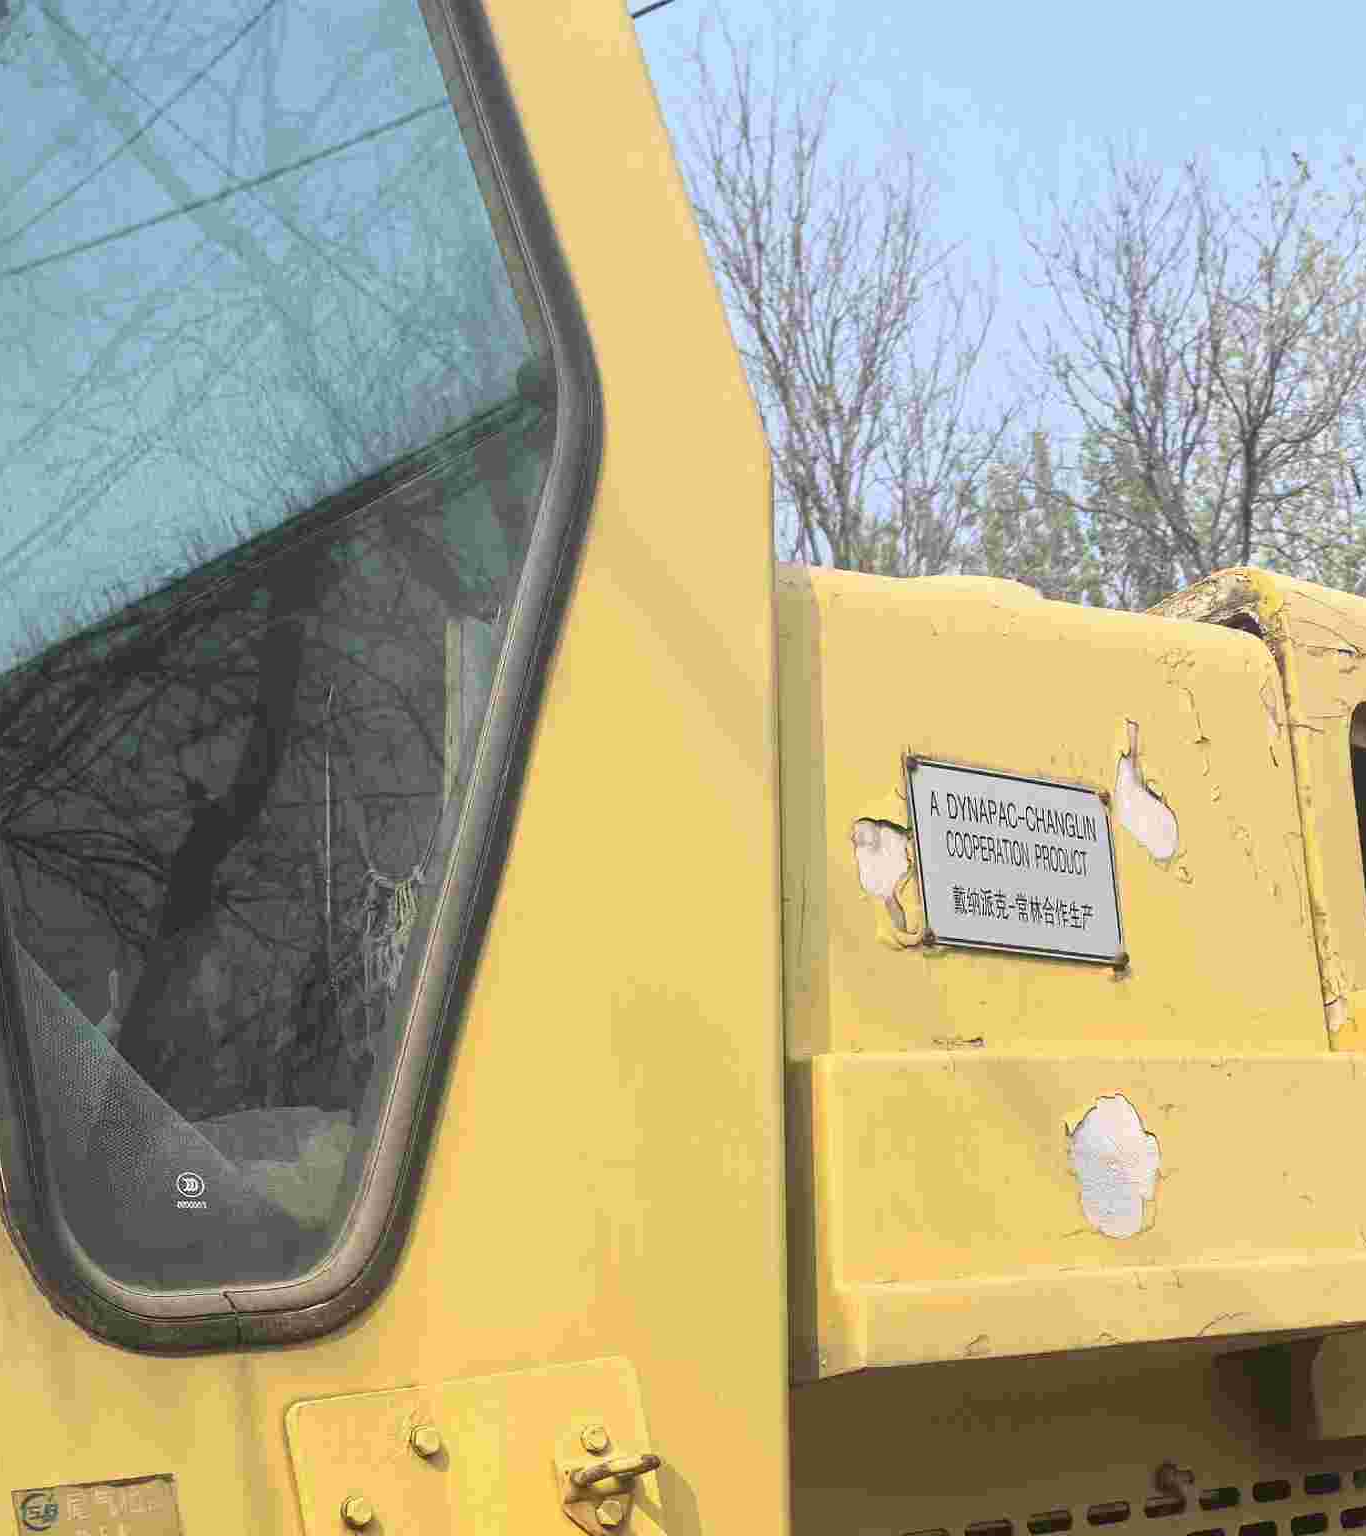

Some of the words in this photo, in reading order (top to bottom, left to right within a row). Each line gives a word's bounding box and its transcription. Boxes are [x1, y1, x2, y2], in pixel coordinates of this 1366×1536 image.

[930, 791, 941, 817] A
[947, 793, 1098, 842] DYNAPAC-CHANGLIN
[946, 830, 1030, 869] COOPERATION
[1034, 844, 1087, 877] PRODUCT
